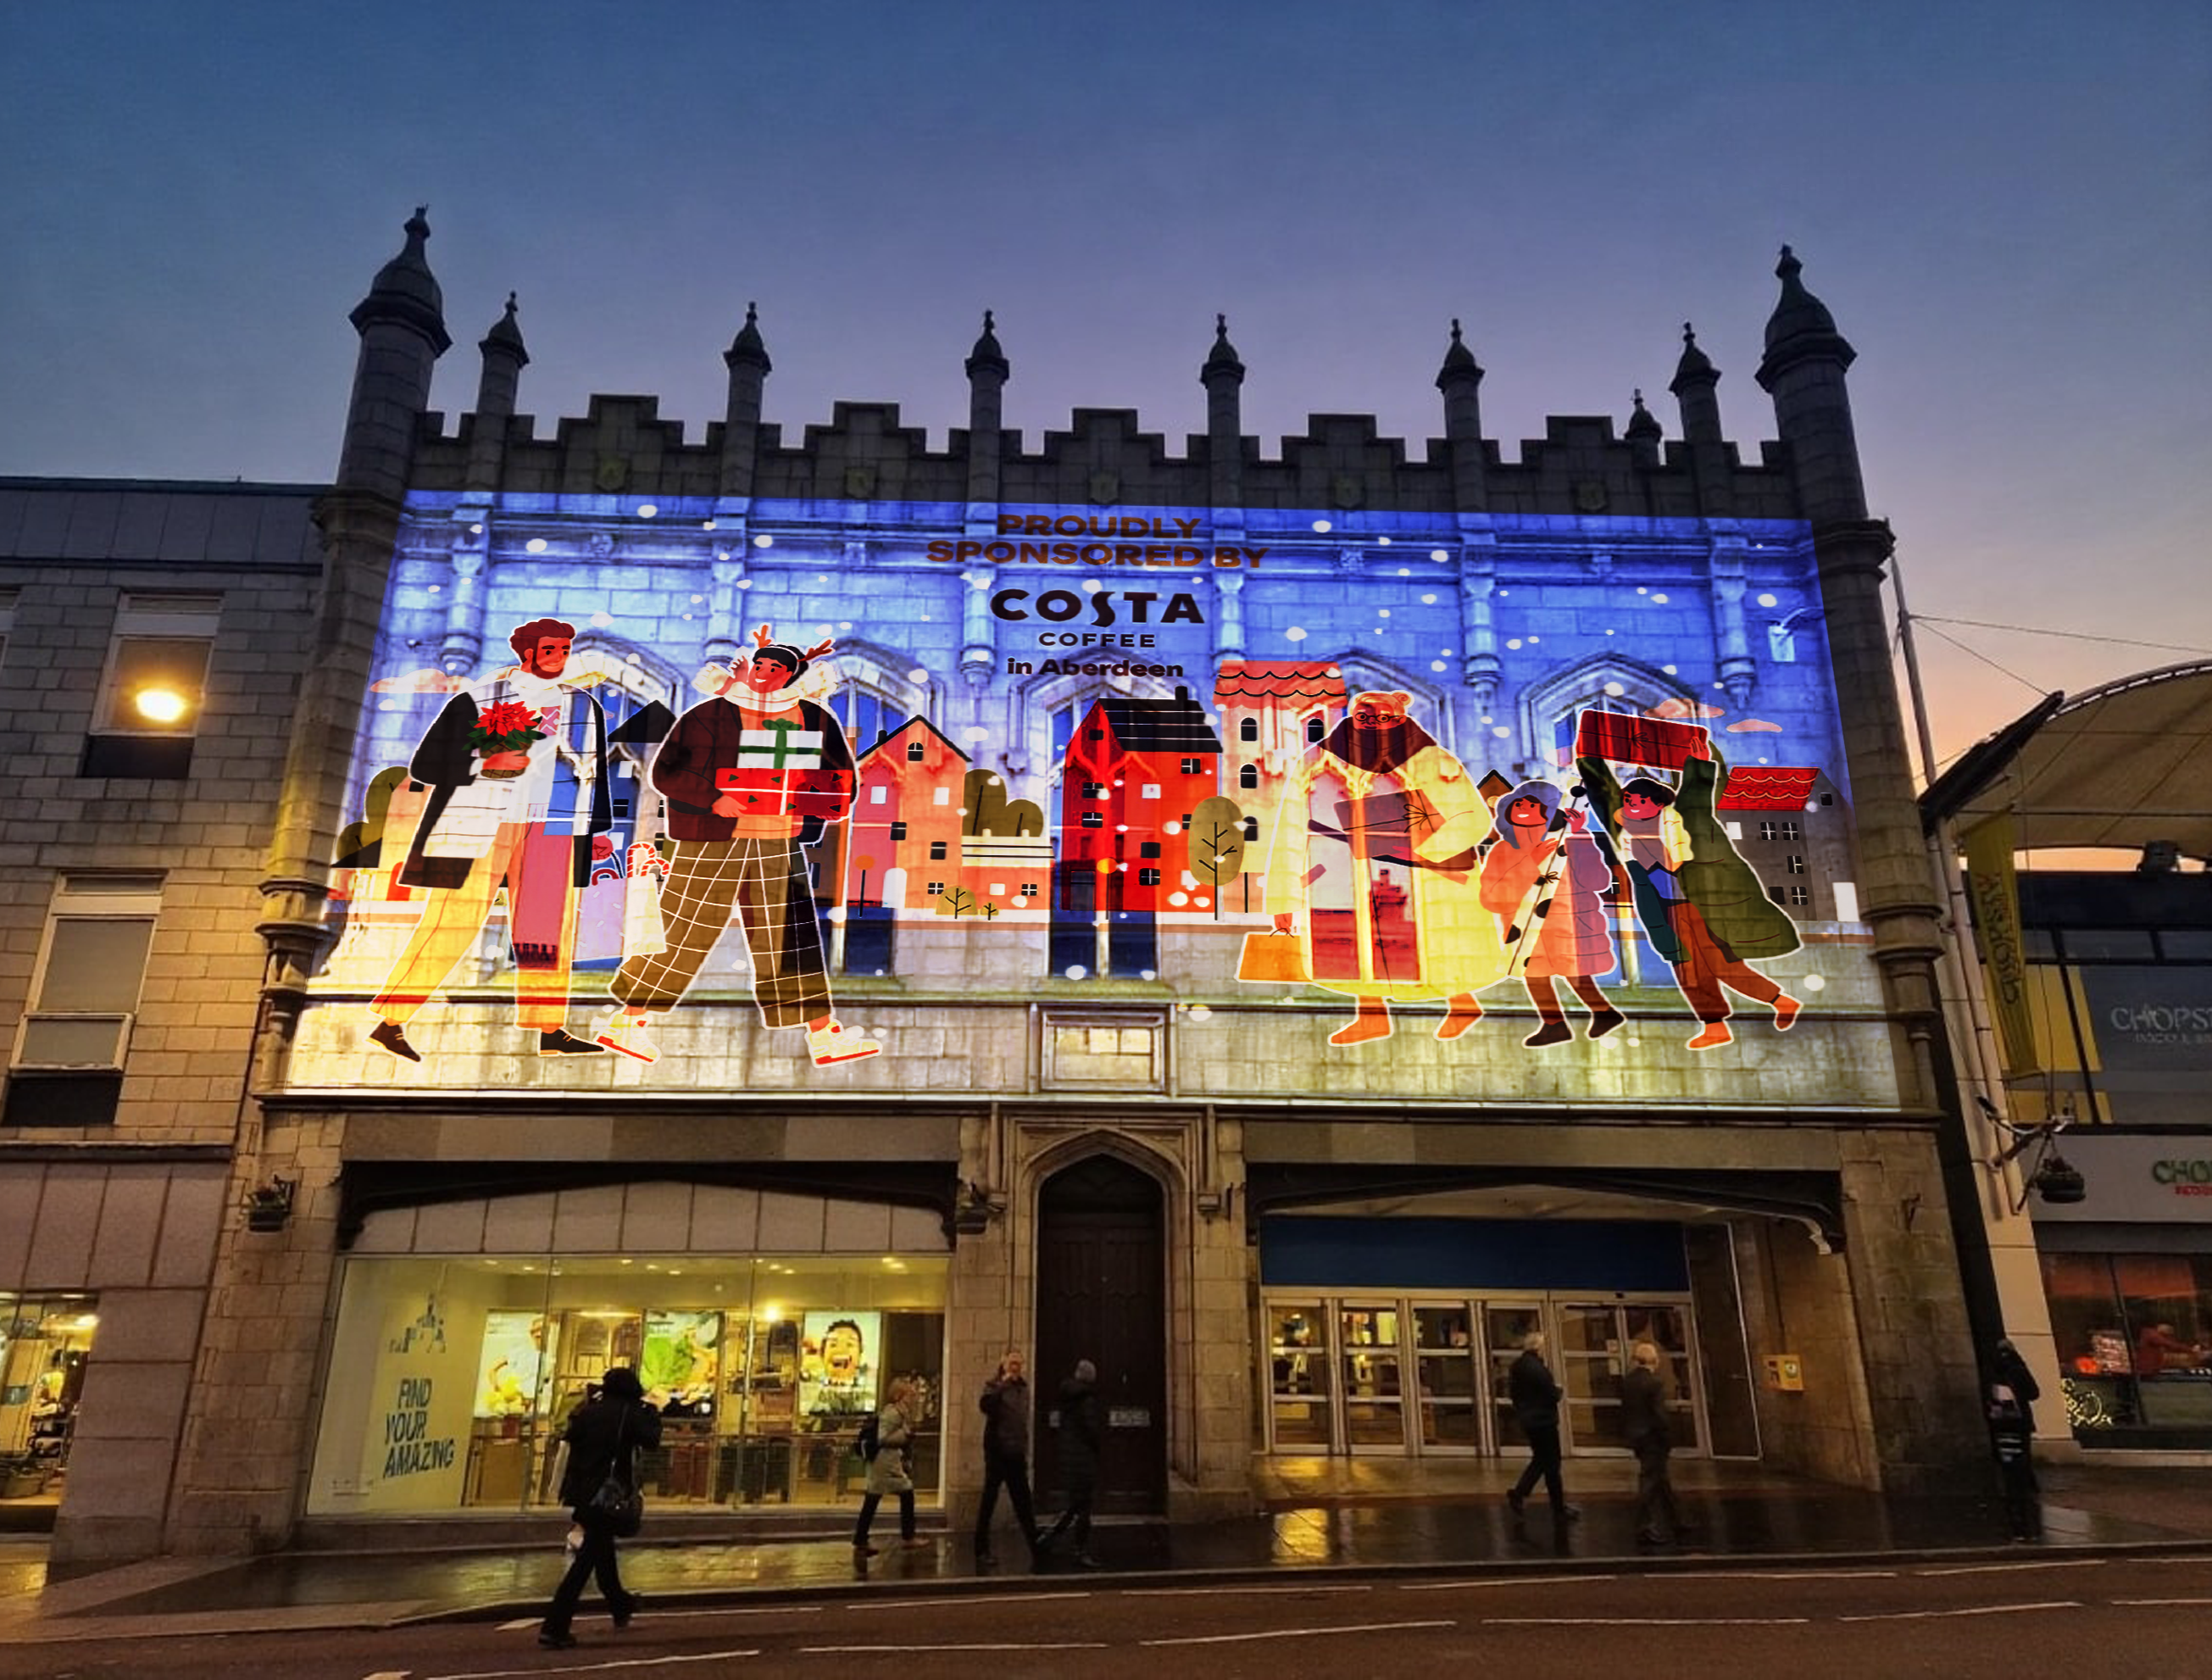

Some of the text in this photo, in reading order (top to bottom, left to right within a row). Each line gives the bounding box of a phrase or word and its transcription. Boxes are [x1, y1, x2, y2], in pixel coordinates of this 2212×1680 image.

[998, 514, 1202, 539] PROUDLY
[926, 540, 1270, 568] SPONSORED BY
[990, 588, 1204, 627] COSTA
[1038, 631, 1155, 648] COFFEE
[1008, 657, 1184, 677] in Aberdeen
[397, 1377, 432, 1409] FIND
[384, 1410, 428, 1444] YOUR
[383, 1439, 454, 1479] AMAZING
